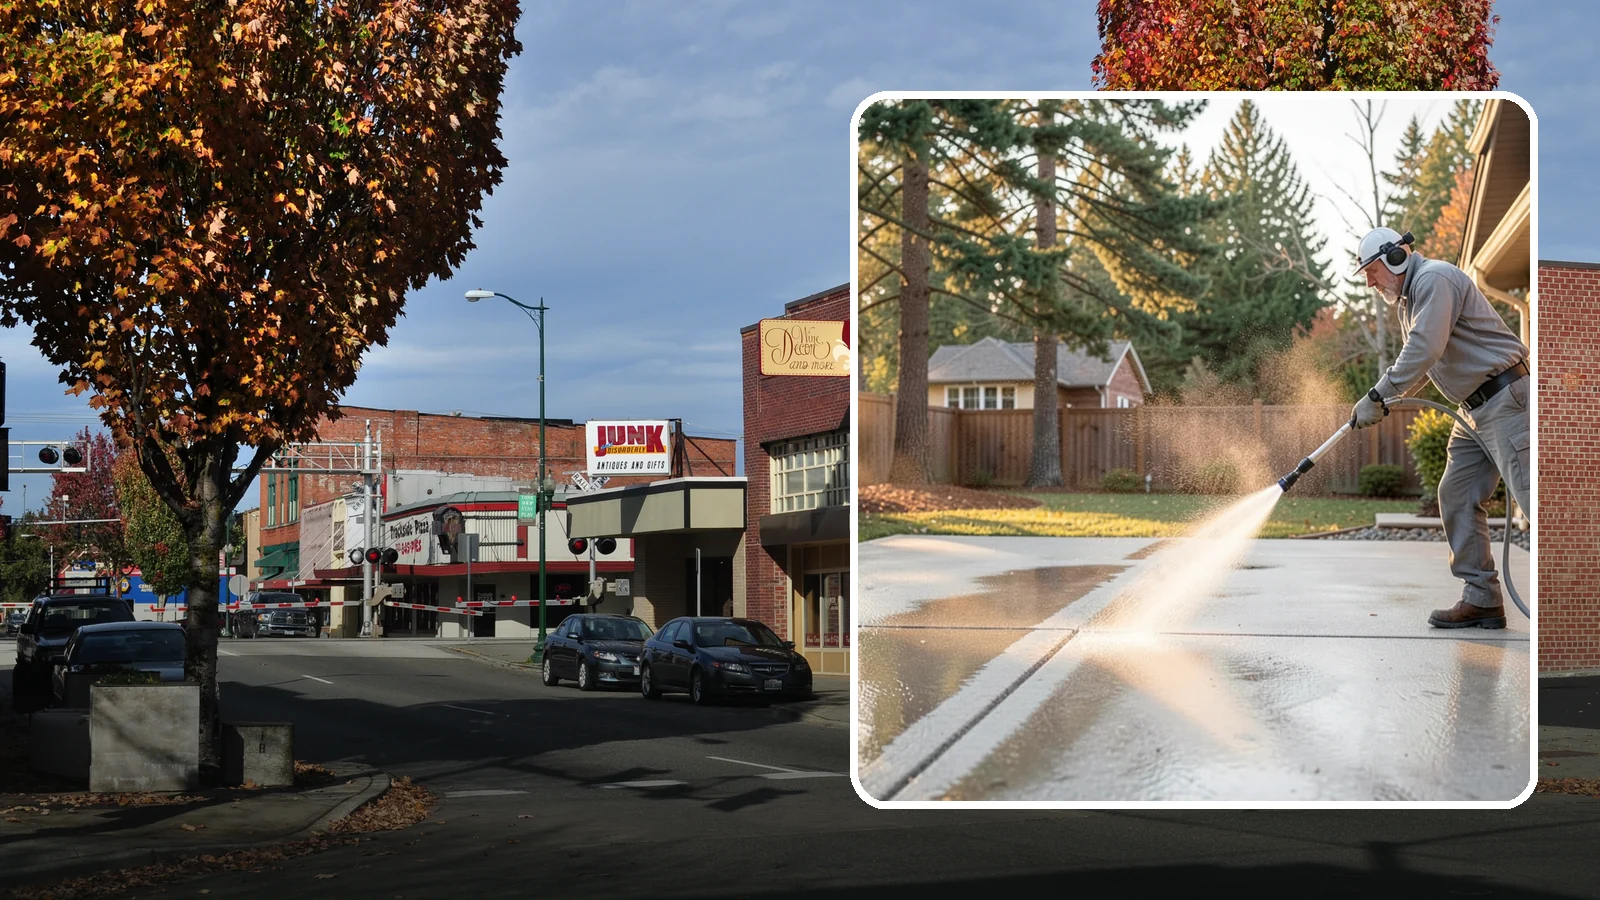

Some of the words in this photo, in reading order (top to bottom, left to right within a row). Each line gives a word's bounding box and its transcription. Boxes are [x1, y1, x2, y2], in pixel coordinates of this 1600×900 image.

[595, 425, 665, 457] JUNK
[597, 461, 628, 470] ANTIQUES
[631, 461, 644, 469] AND
[647, 461, 665, 469] GIFTS
[390, 522, 413, 540] Trackside
[415, 519, 429, 535] Pizza
